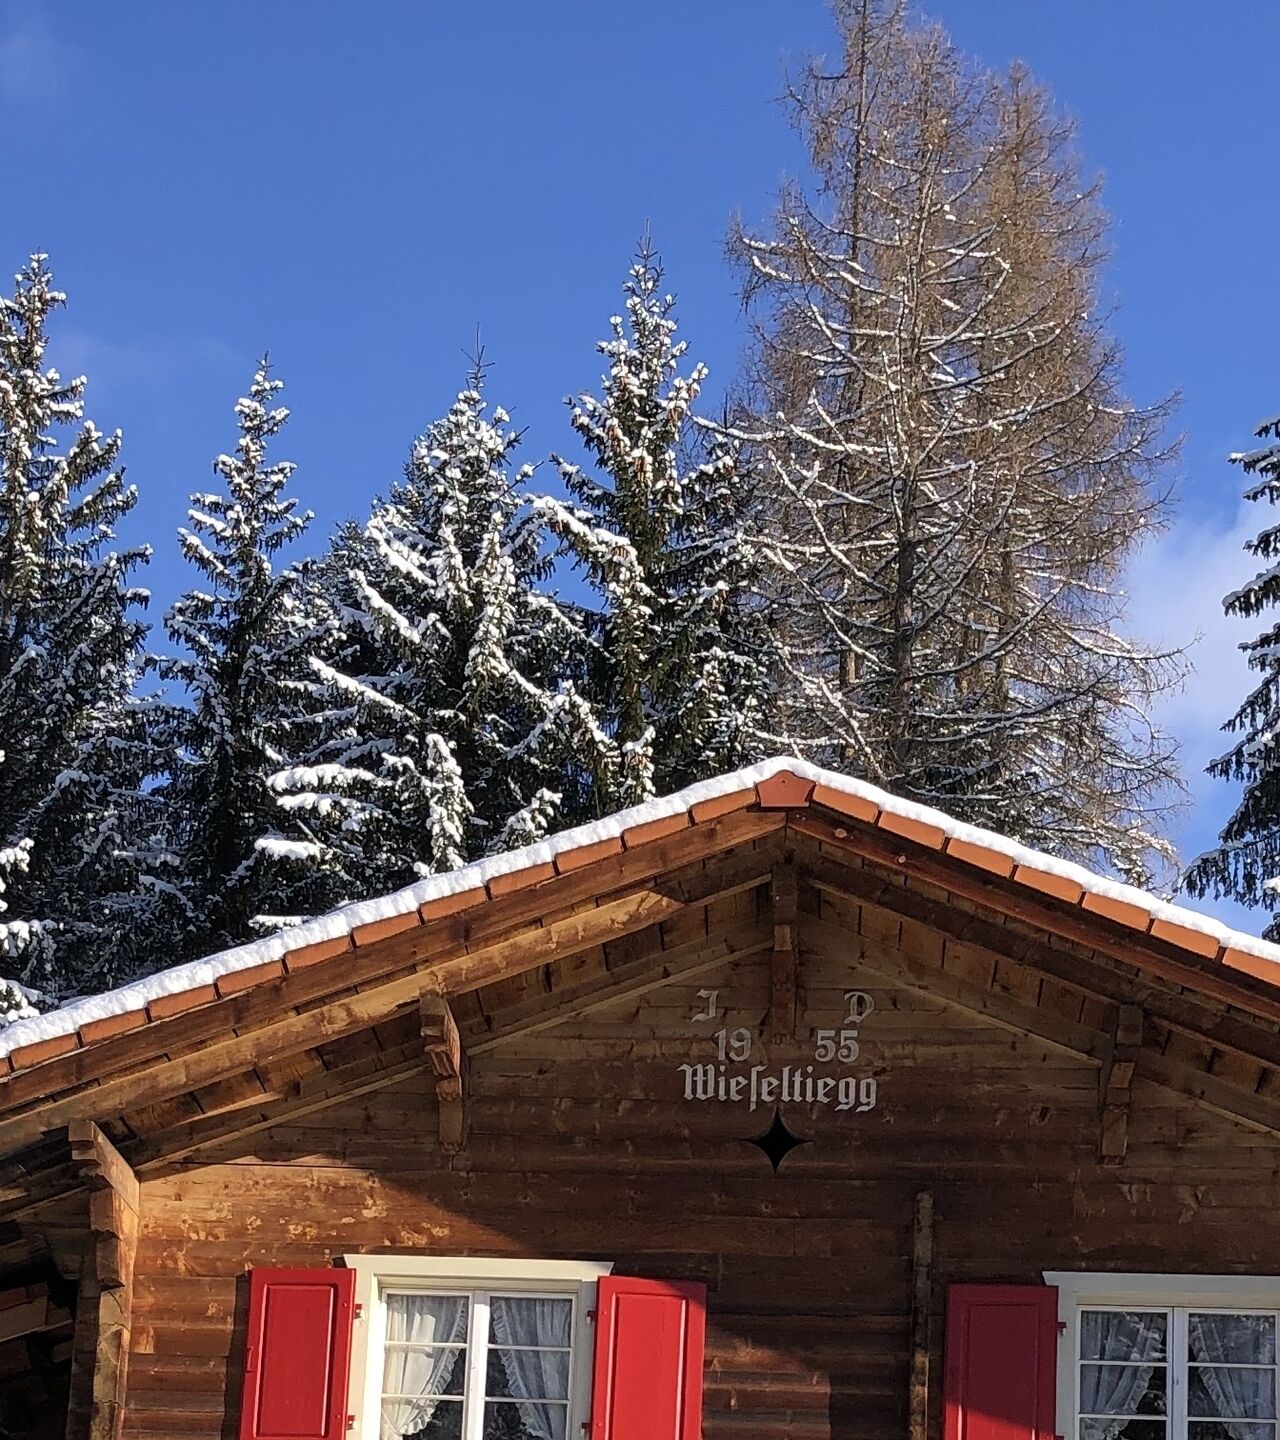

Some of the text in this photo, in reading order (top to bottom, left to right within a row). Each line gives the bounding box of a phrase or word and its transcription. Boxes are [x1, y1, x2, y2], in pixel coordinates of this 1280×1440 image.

[844, 991, 875, 1024] D
[714, 1027, 860, 1063] 19 55
